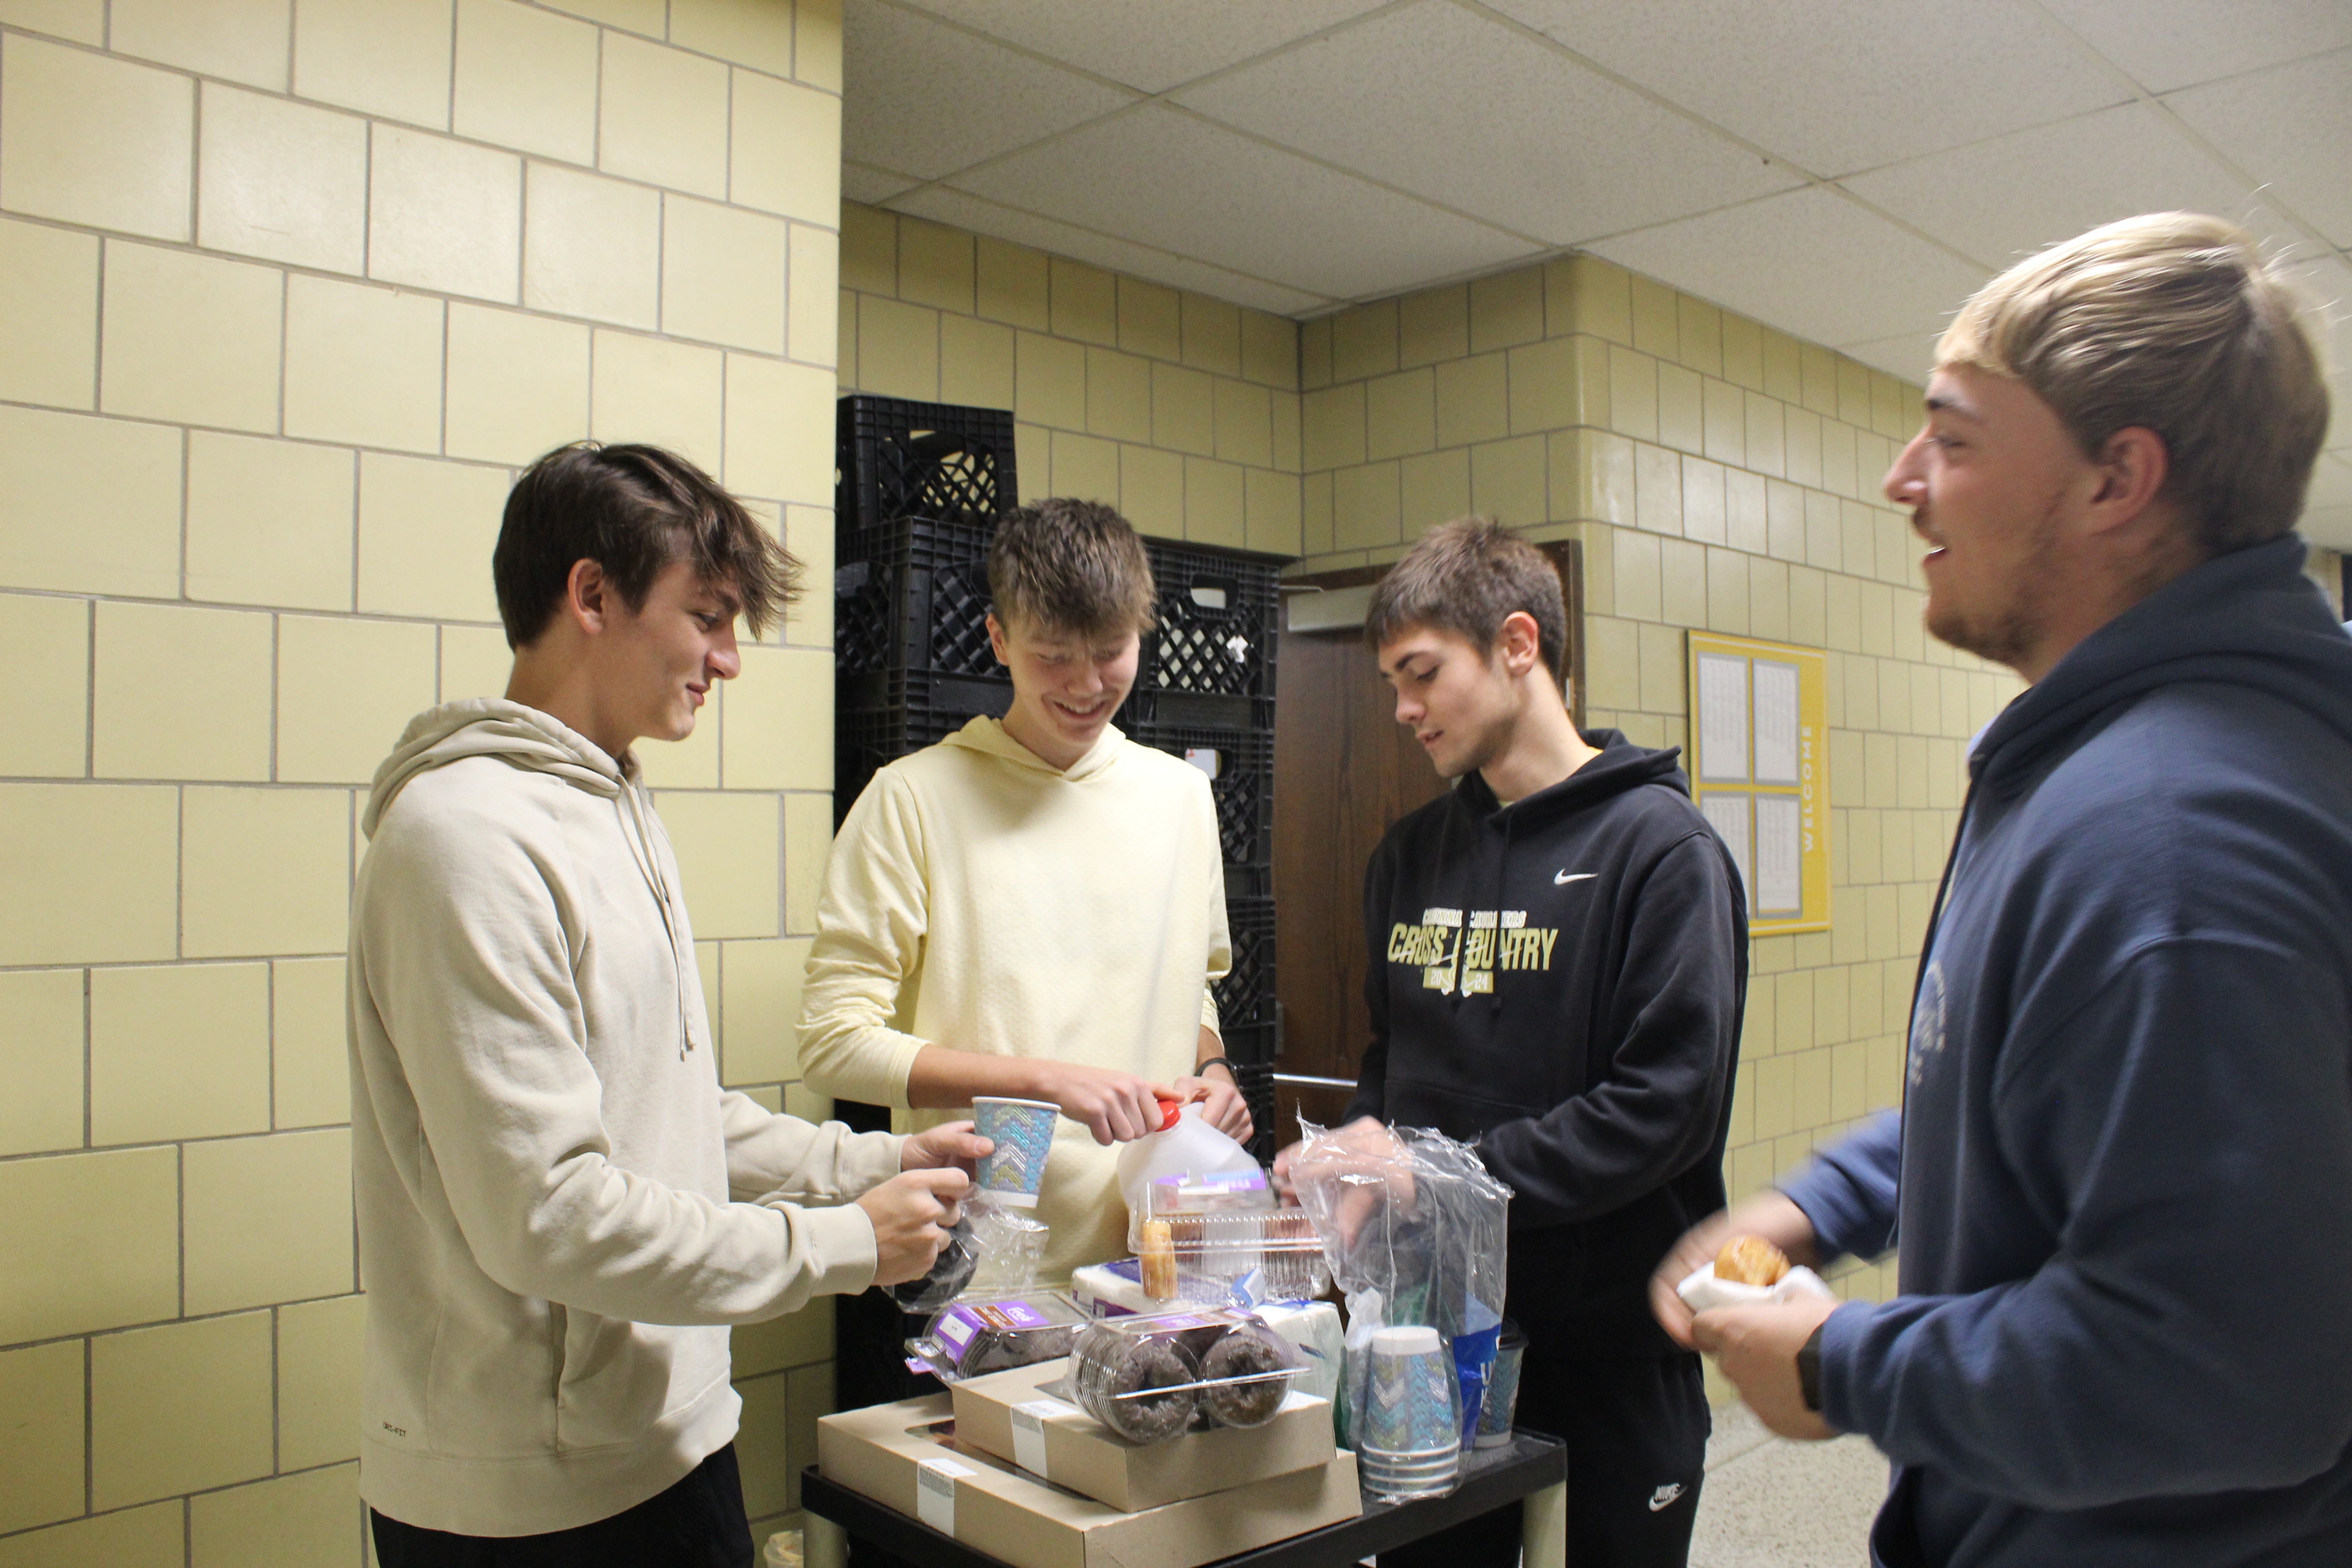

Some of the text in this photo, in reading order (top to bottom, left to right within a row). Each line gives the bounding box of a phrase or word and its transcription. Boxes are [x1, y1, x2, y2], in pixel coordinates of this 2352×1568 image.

[1802, 725, 1814, 853] WELCOME
[1387, 922, 1448, 965] CROSS
[1431, 969, 1488, 990] 20 24
